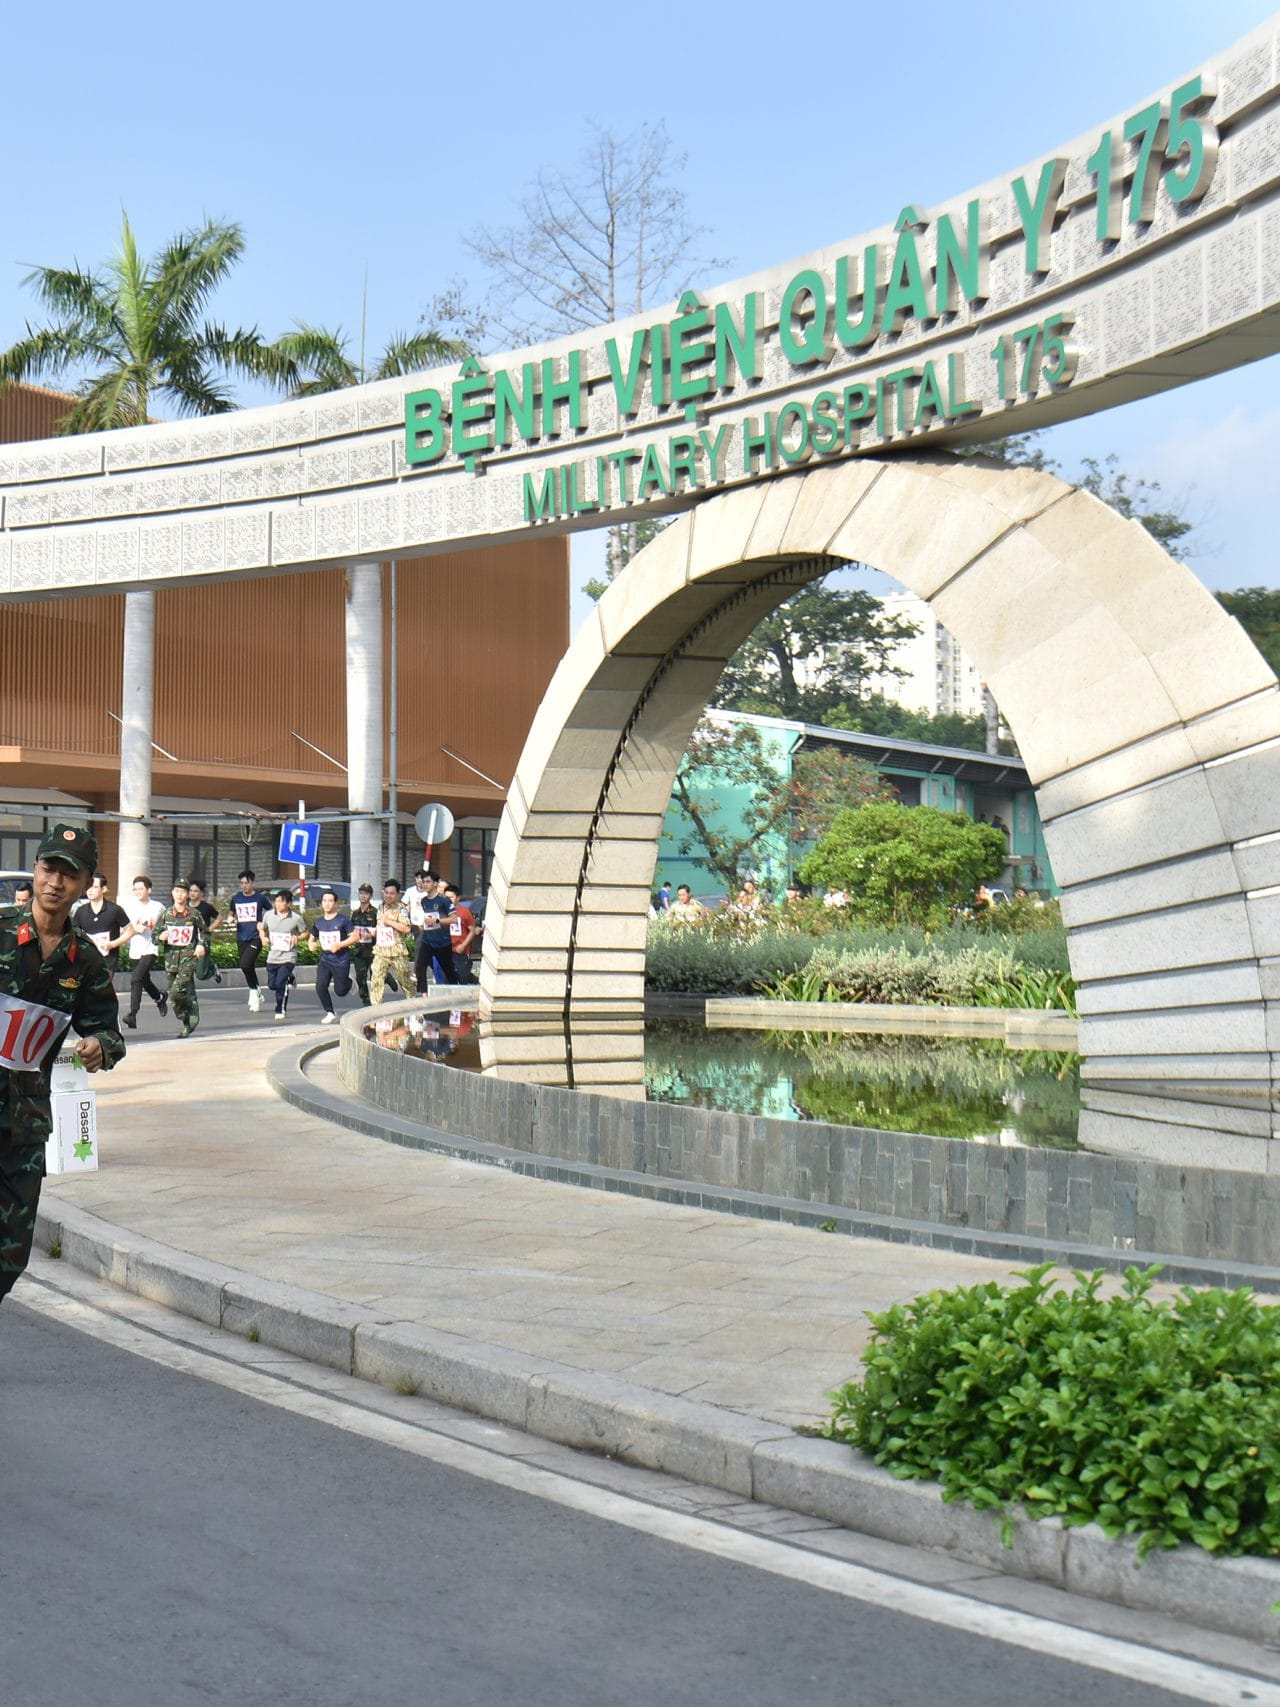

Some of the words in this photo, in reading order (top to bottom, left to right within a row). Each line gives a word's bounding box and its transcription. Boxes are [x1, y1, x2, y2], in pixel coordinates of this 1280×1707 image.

[405, 357, 584, 473] BỆNH
[604, 290, 757, 421] VIỆN
[780, 205, 980, 365] QUÂN
[1011, 158, 1059, 274] Y
[1087, 75, 1207, 241] 175
[523, 424, 728, 522] MILITARY
[743, 352, 980, 473] HOSPITAL
[991, 311, 1068, 400] 175
[170, 928, 191, 944] 28
[80, 1101, 93, 1145] Dasani
